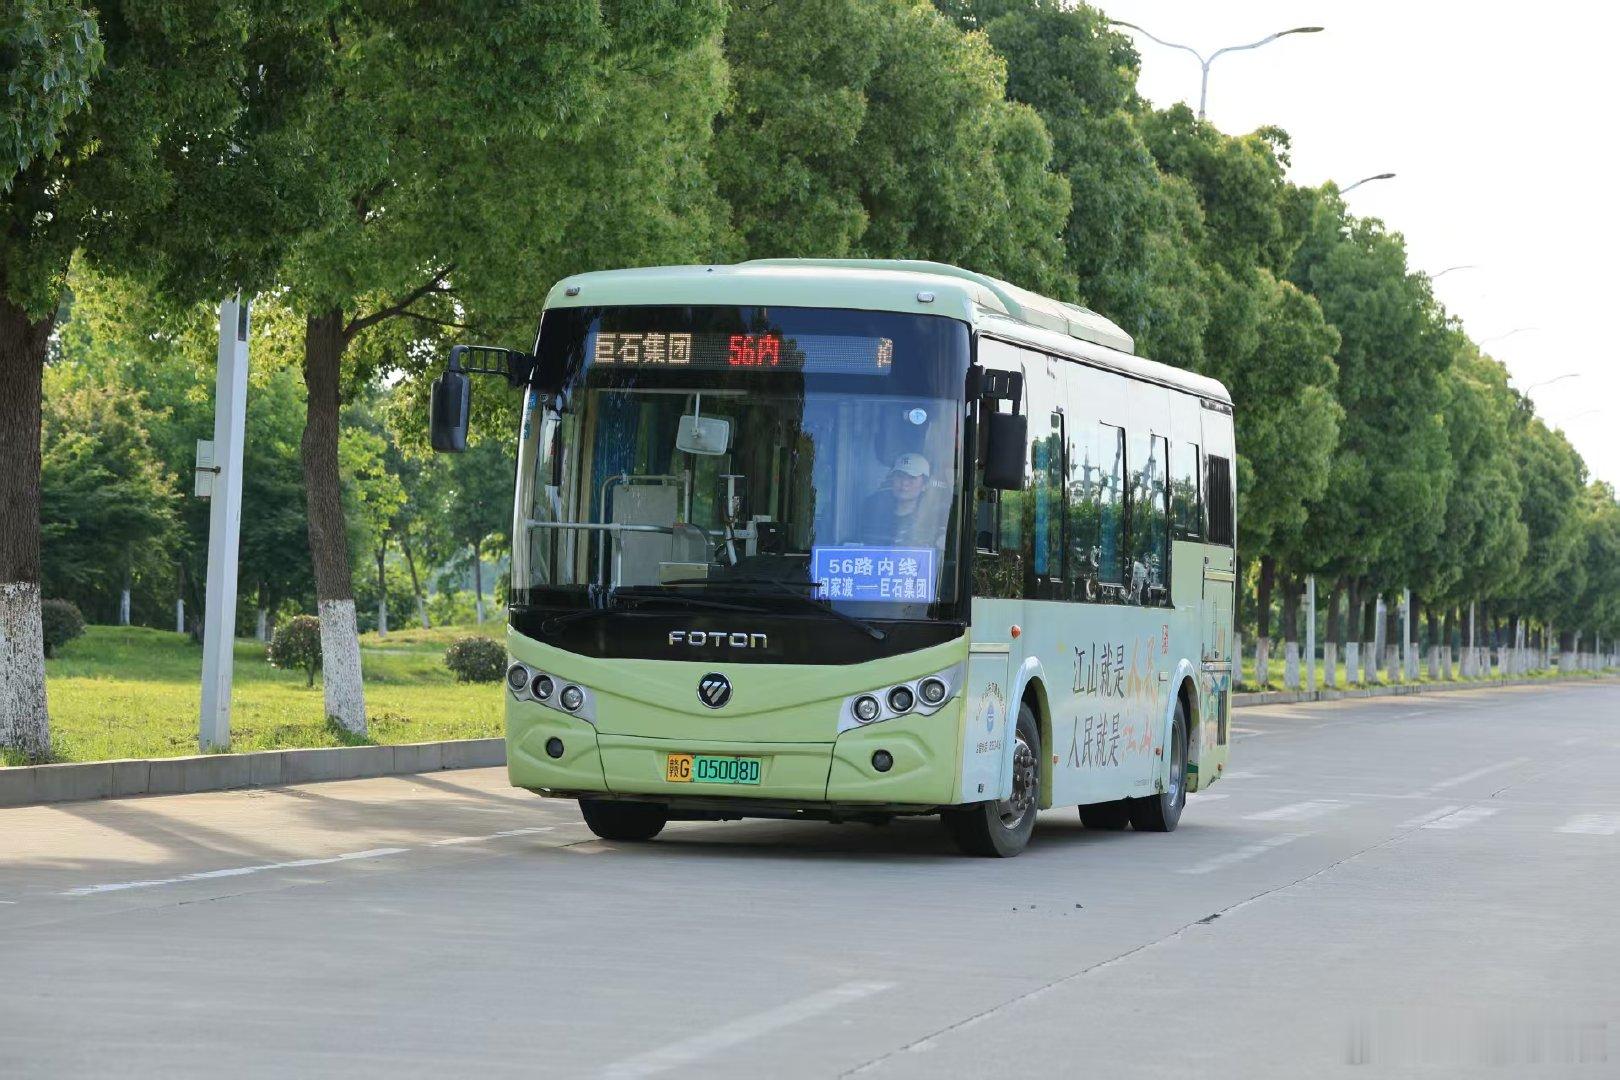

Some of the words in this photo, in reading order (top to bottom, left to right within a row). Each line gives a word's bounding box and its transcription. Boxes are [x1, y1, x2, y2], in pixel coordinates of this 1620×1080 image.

[594, 332, 693, 364] 巨石集团
[728, 334, 780, 366] 56内
[829, 557, 918, 576] 56路内线
[668, 631, 768, 649] FOTON
